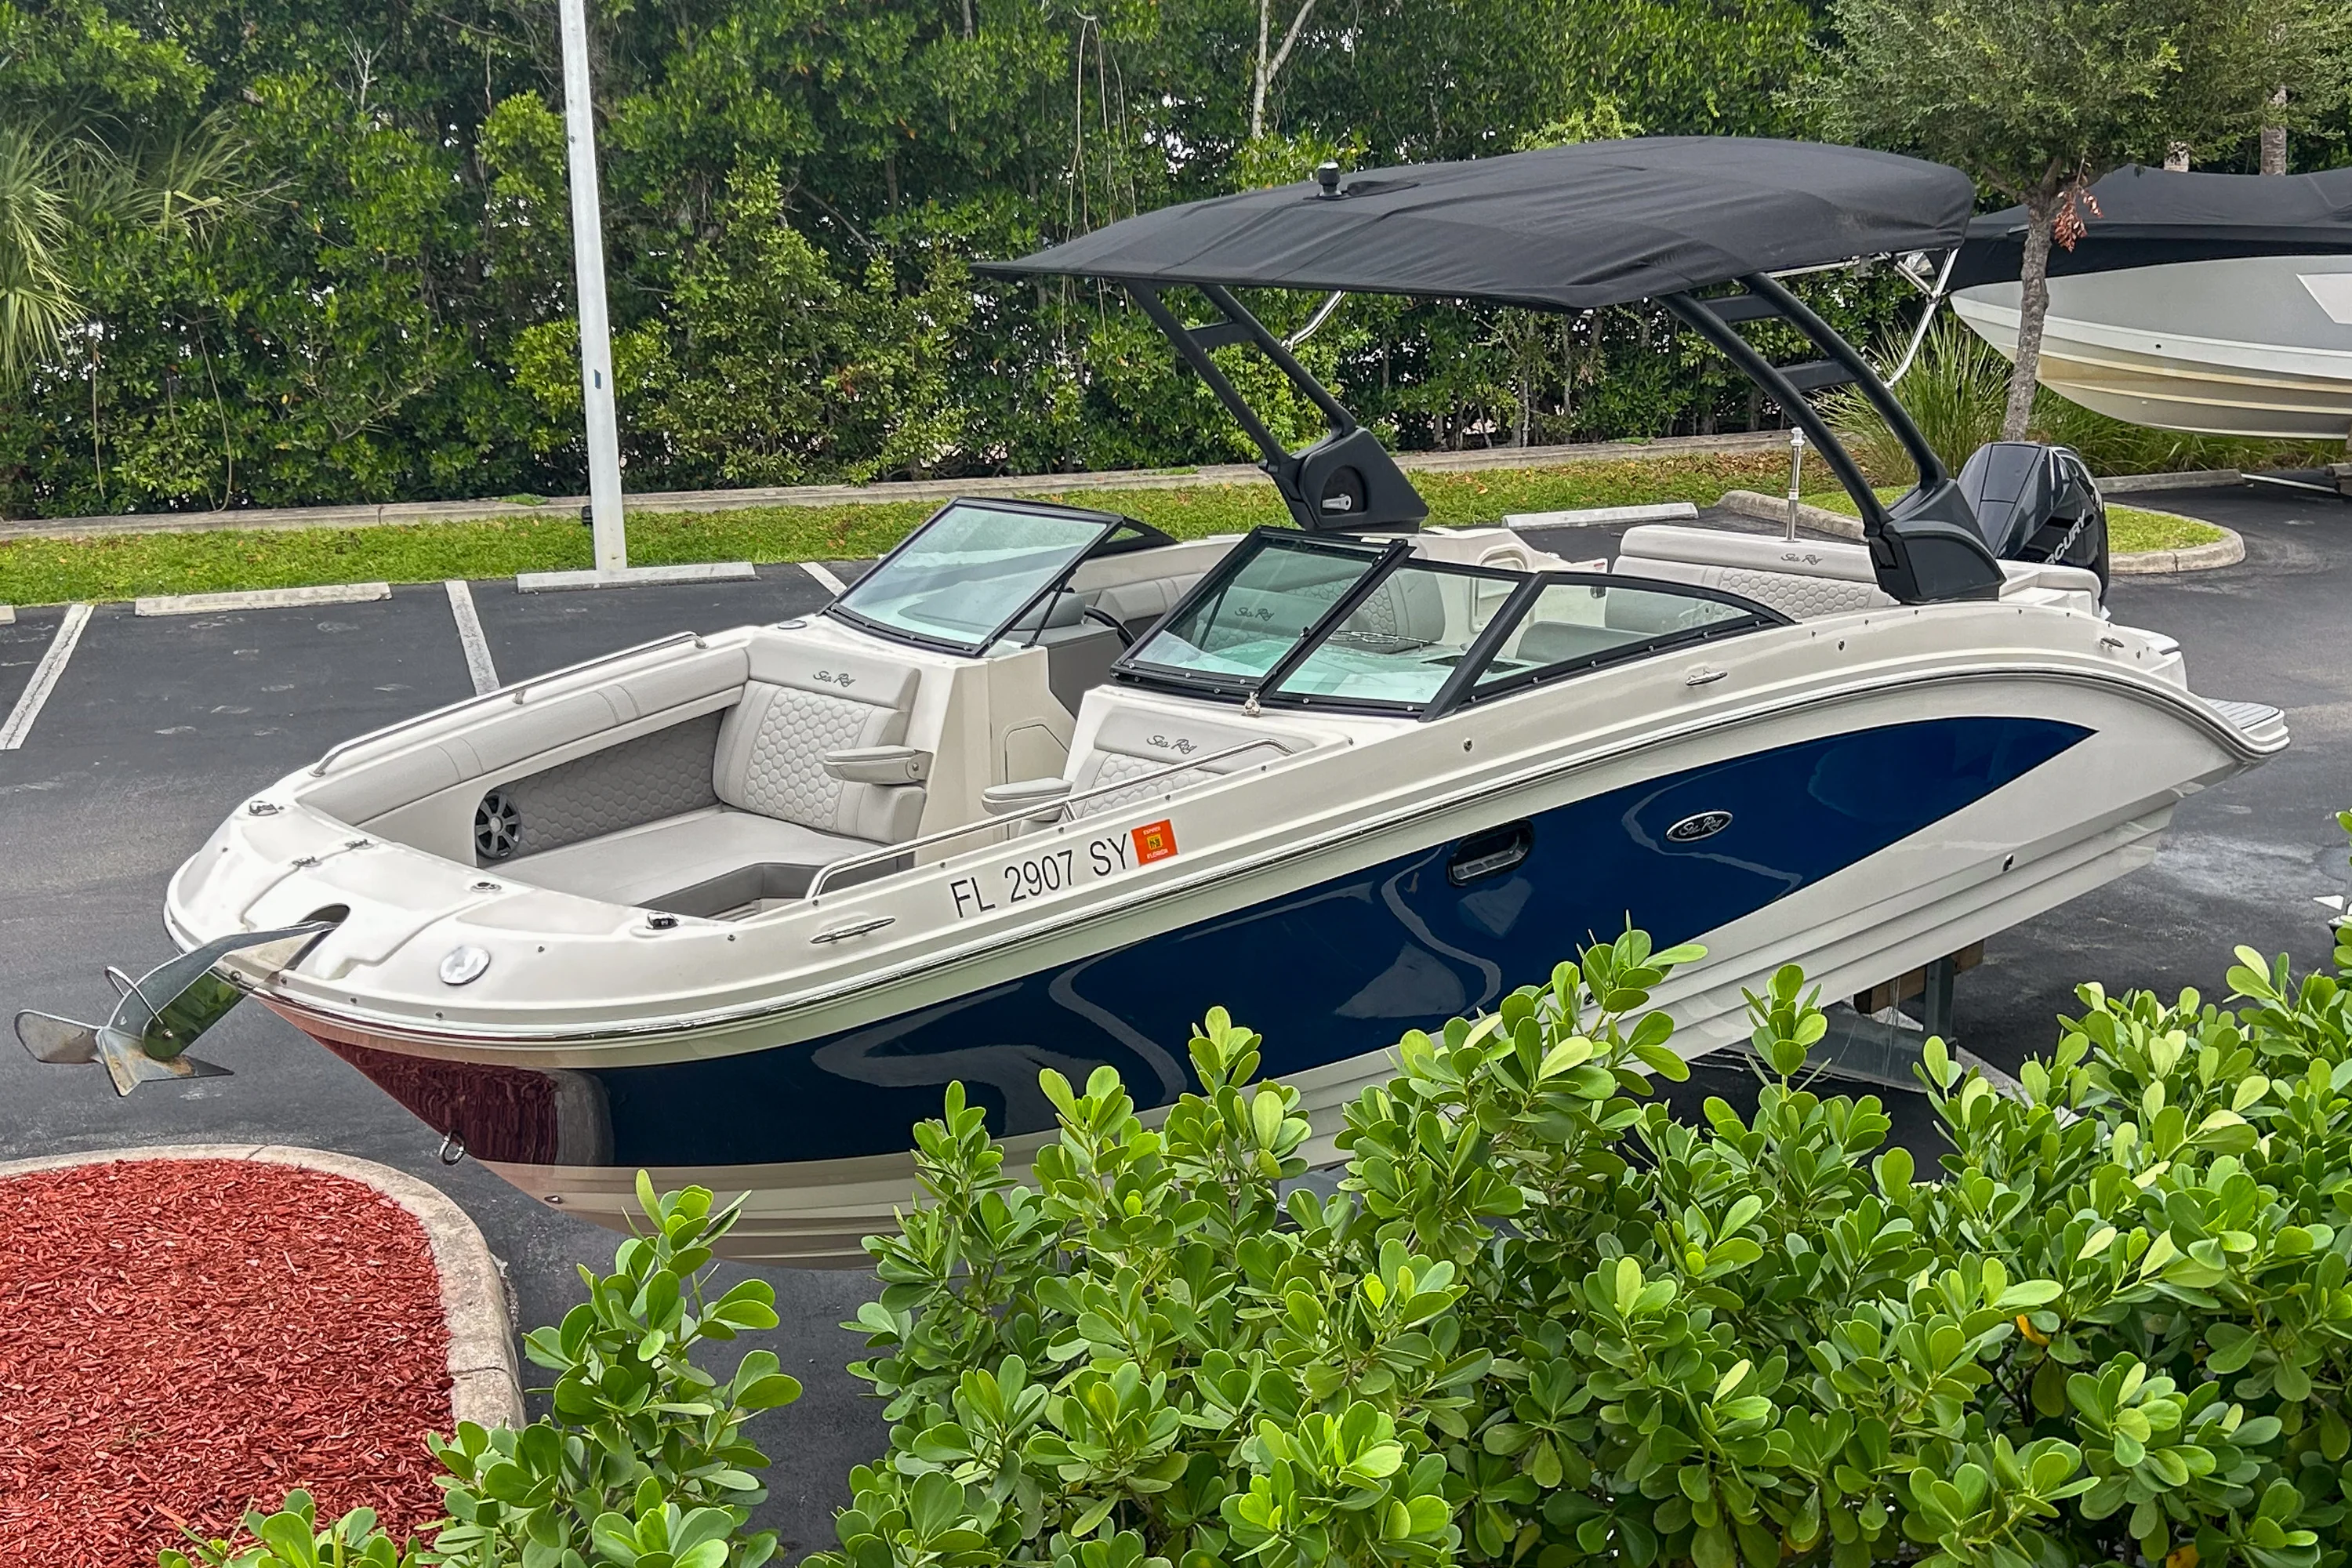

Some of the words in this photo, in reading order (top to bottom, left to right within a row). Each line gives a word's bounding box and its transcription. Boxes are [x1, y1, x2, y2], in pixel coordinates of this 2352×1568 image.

[2045, 508, 2085, 564] RCURY
[1780, 553, 1801, 562] Sea
[1801, 554, 1824, 565] Ray
[1234, 607, 1254, 618] Sea
[1254, 608, 1275, 622] Ray
[813, 670, 832, 683] Sea
[833, 673, 857, 688] Ray
[1146, 735, 1171, 748] Sea
[1171, 739, 1198, 755] Ray
[1679, 822, 1700, 837] Sea
[1700, 815, 1724, 832] Ray
[949, 877, 996, 919] FL
[1004, 849, 1073, 903] 2907
[1089, 833, 1127, 877] SY
